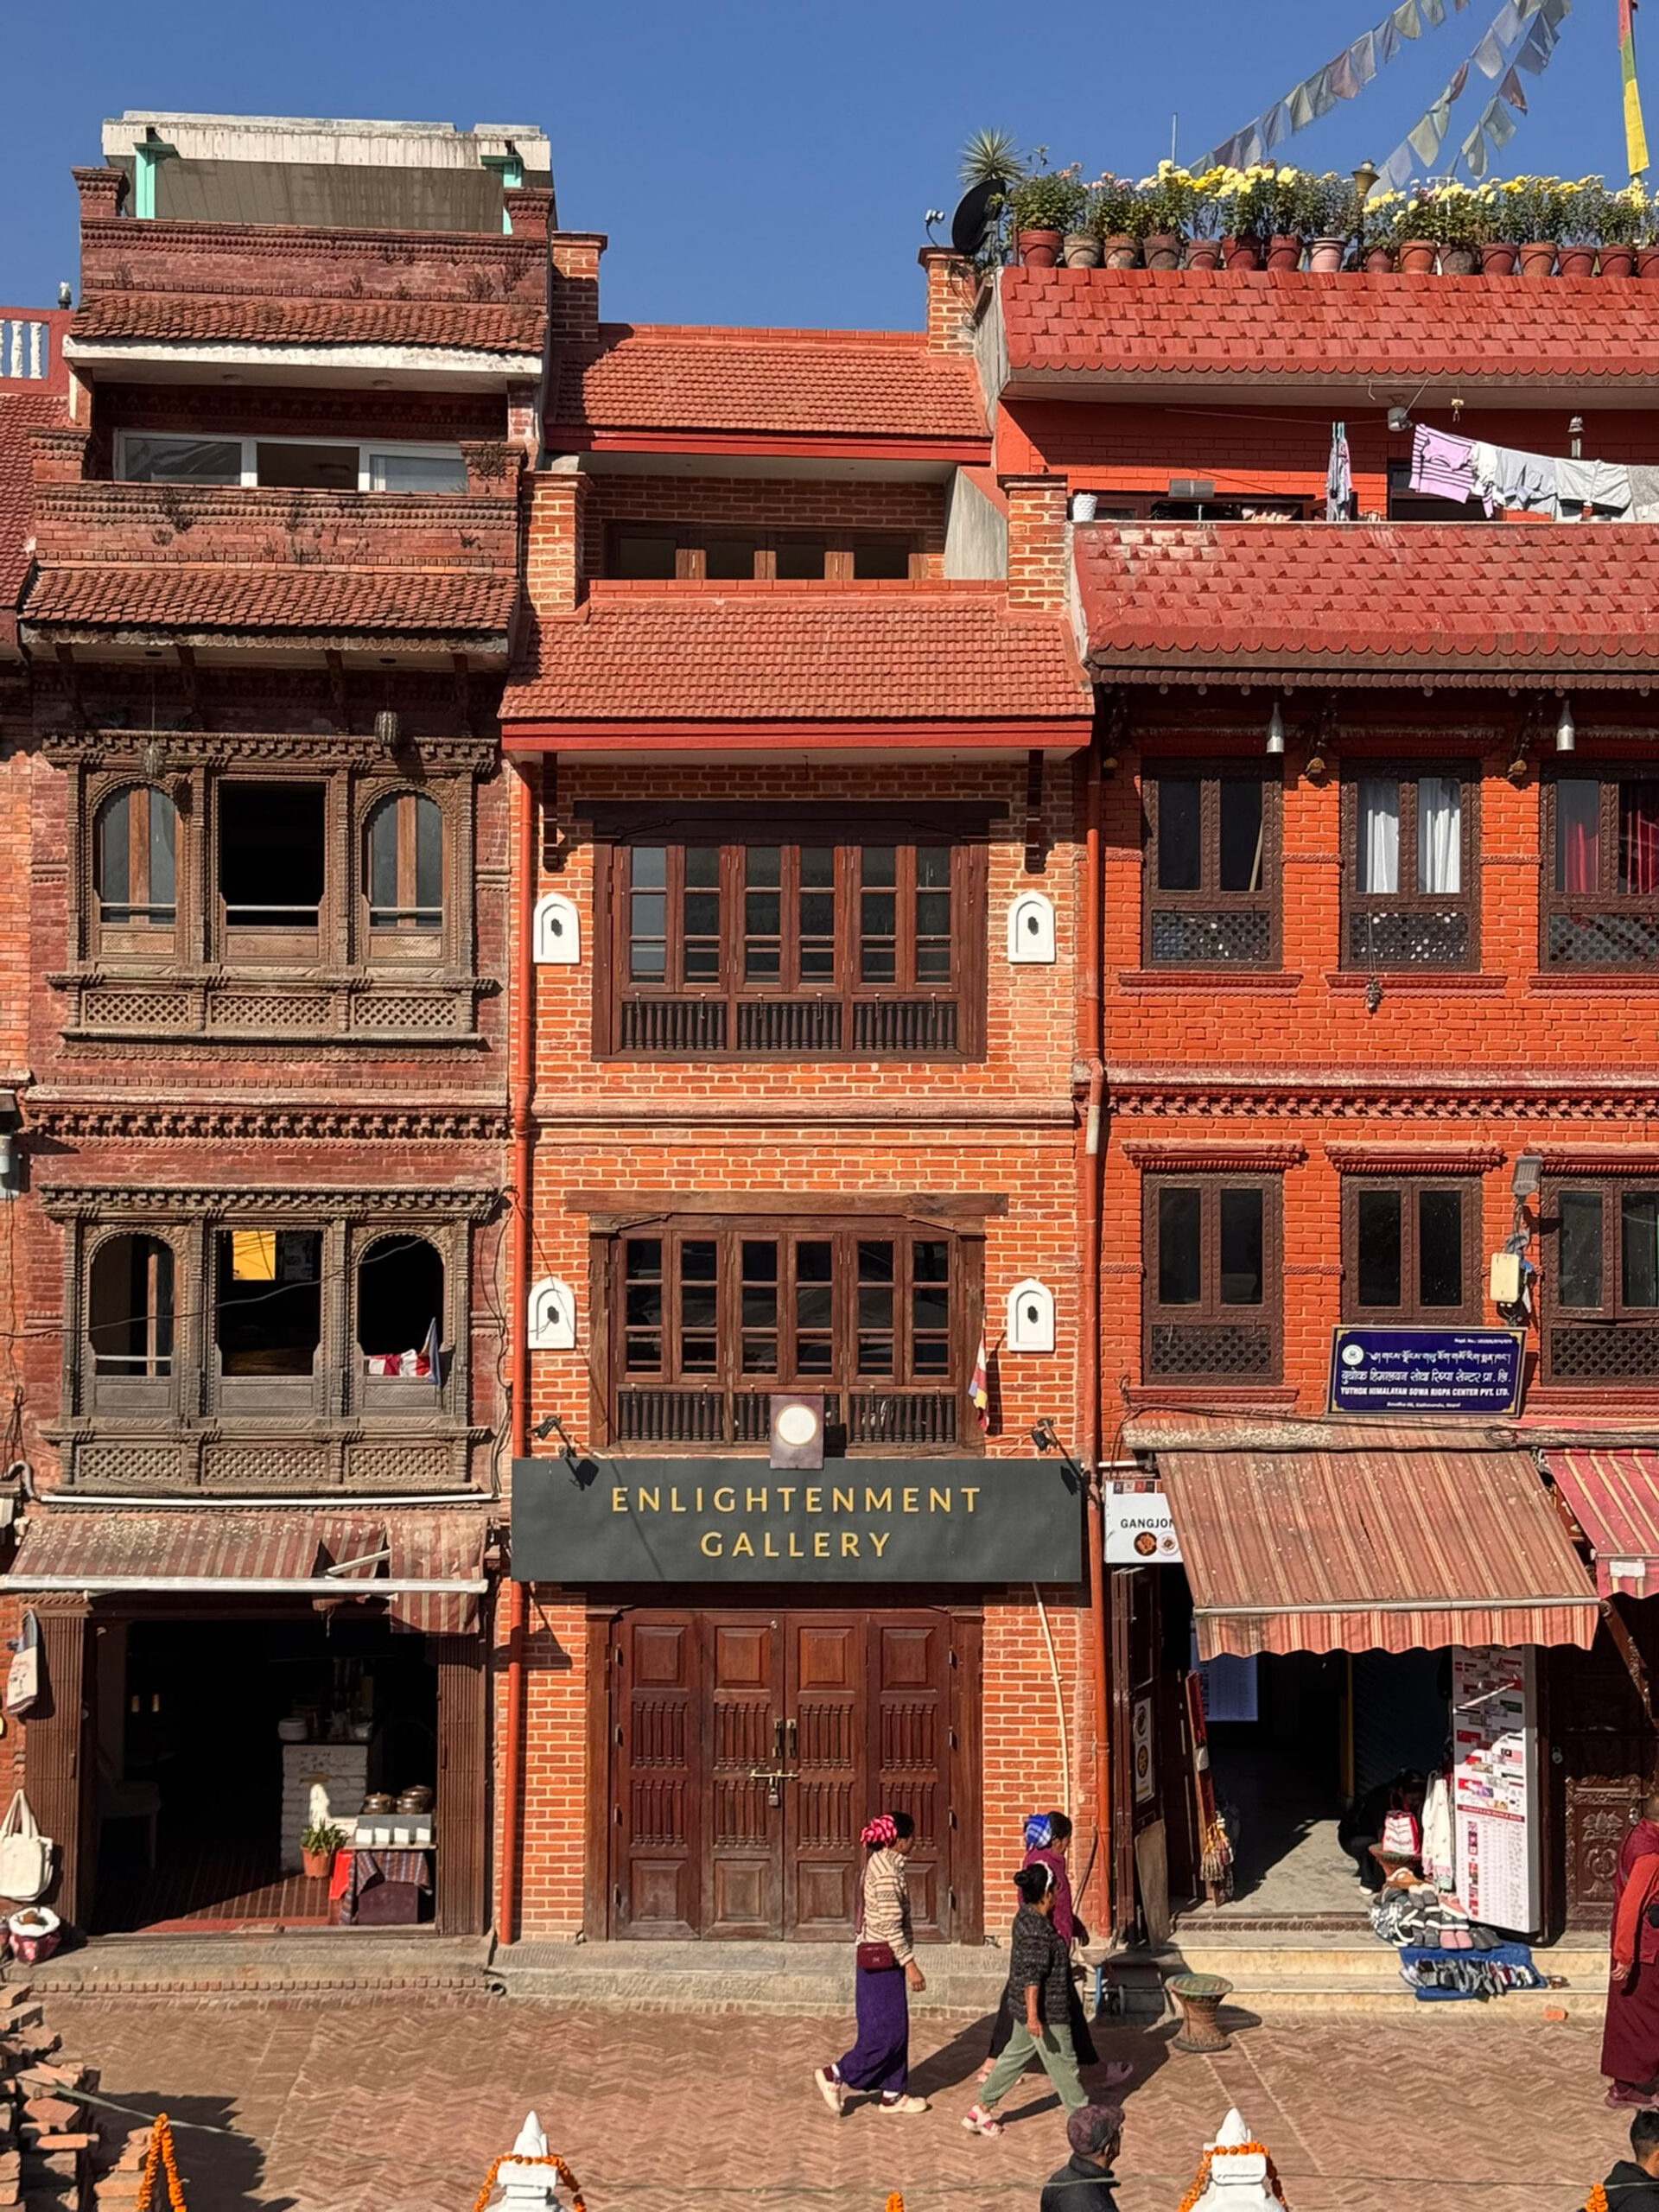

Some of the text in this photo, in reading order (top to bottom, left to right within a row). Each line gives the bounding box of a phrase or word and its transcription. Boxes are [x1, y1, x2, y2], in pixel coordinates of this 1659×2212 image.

[1340, 1386, 1368, 1396] YUTHOK
[1369, 1387, 1408, 1396] HIMALAYAN
[1409, 1387, 1429, 1396] SOWA
[1430, 1388, 1452, 1397] RIGPA
[1452, 1388, 1479, 1397] CENTER
[1496, 1389, 1510, 1397] LTD.
[612, 1486, 981, 1513] ENLIGHTENMENT
[701, 1531, 891, 1557] GALLERY
